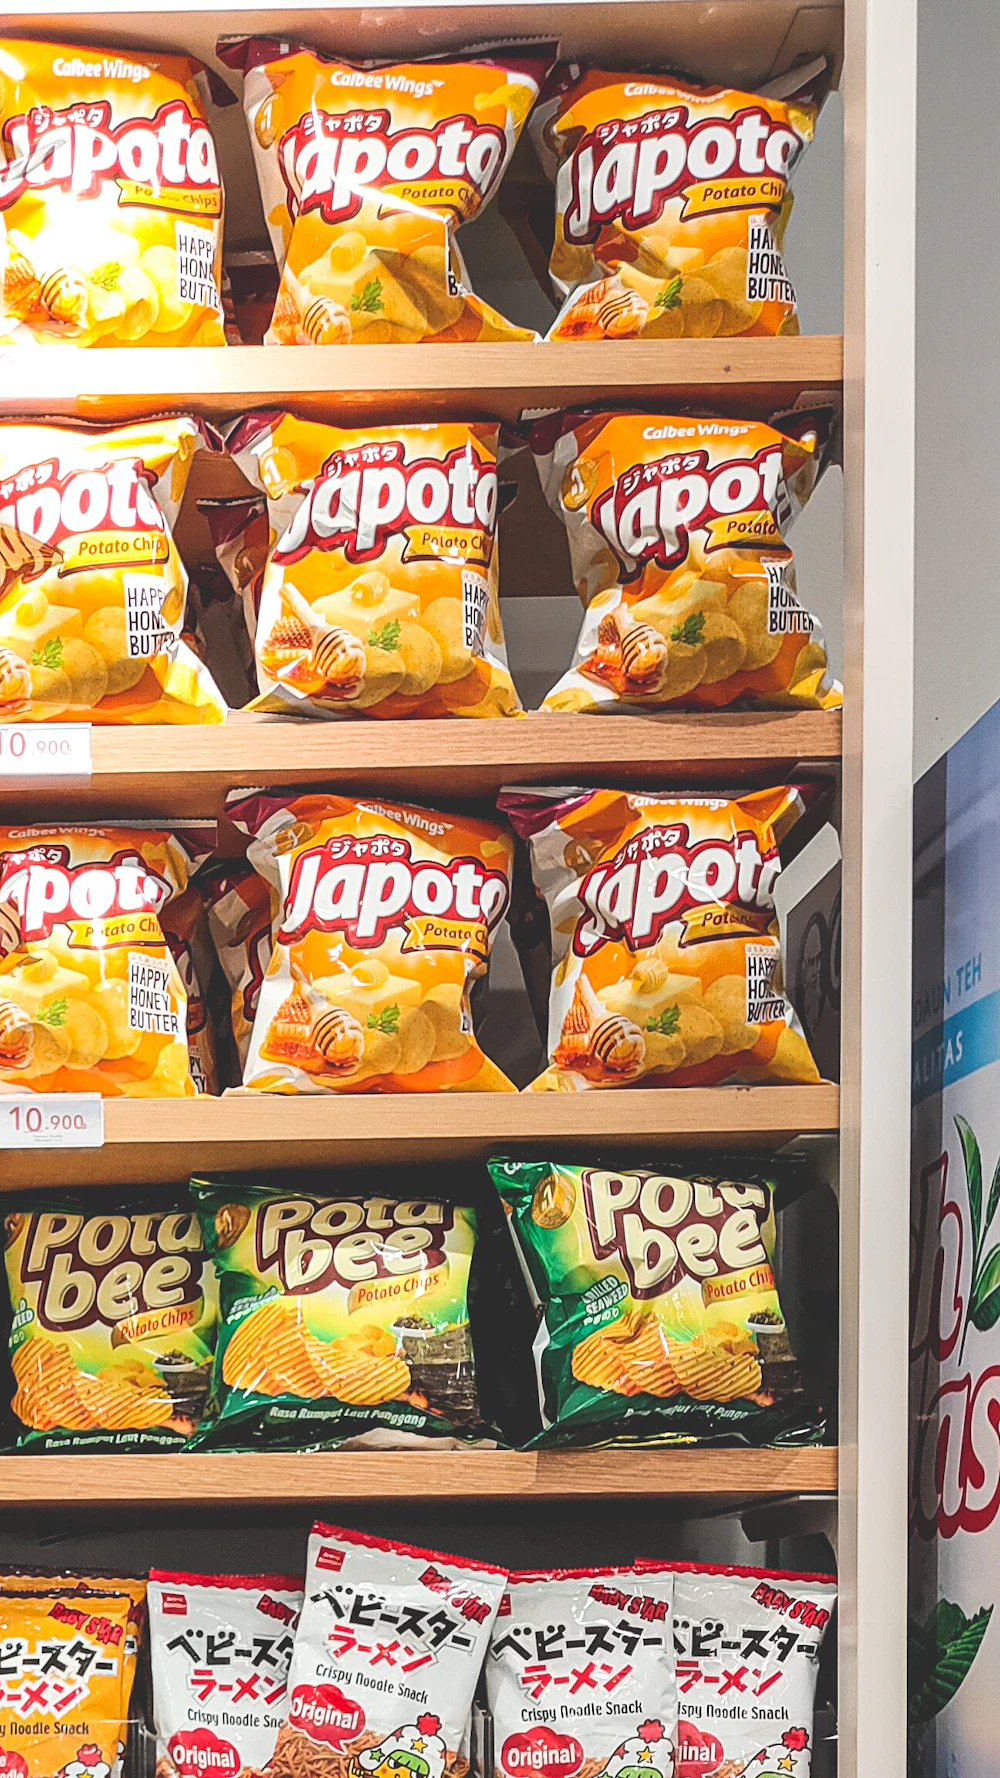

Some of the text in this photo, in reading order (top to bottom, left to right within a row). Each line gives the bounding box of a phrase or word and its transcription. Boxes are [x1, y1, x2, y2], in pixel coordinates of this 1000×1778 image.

[101, 60, 150, 83] Wings
[330, 71, 435, 99] Calbee Wings
[598, 112, 678, 146] ジャポタ
[702, 184, 756, 203] Potato
[642, 424, 749, 445] Calbee Wings
[327, 446, 397, 482] ジャポタ
[623, 456, 700, 496] ジャポタ
[331, 842, 406, 864] ジャポタ
[131, 965, 169, 992] HAPPY
[956, 952, 982, 998] TEH
[131, 990, 169, 1012] HONEY
[131, 1015, 180, 1034] BUTTER
[8, 1106, 83, 1138] 10.900
[27, 1212, 204, 1272] Pota
[262, 1196, 444, 1261] Pota
[283, 1226, 433, 1291] bee
[623, 1208, 767, 1291] bee
[44, 1253, 190, 1323] bee
[358, 1284, 401, 1304] Potato
[706, 1279, 747, 1300] Potato
[161, 1308, 195, 1335] Chips
[270, 1405, 298, 1419] Rasa
[299, 1408, 343, 1424] Rumput
[311, 1583, 473, 1648] ベビースター
[628, 1596, 670, 1623] STAR
[751, 1582, 830, 1630] BABY STAR
[328, 1623, 433, 1674] ラーメン
[492, 1617, 664, 1661] ベビースター
[192, 1668, 288, 1706] ラーメン
[316, 1662, 429, 1706] Crispy Snack
[521, 1660, 634, 1700] ラーメン
[675, 1660, 784, 1698] ラーメン
[187, 1712, 261, 1734] Crispy Noodle
[290, 1695, 360, 1736] Original
[520, 1700, 644, 1725] Crispy Noodle Snack
[750, 1704, 790, 1720] Snack
[9, 1721, 50, 1738] Noodle
[52, 1721, 90, 1737] Snack
[507, 1743, 577, 1775] Original
